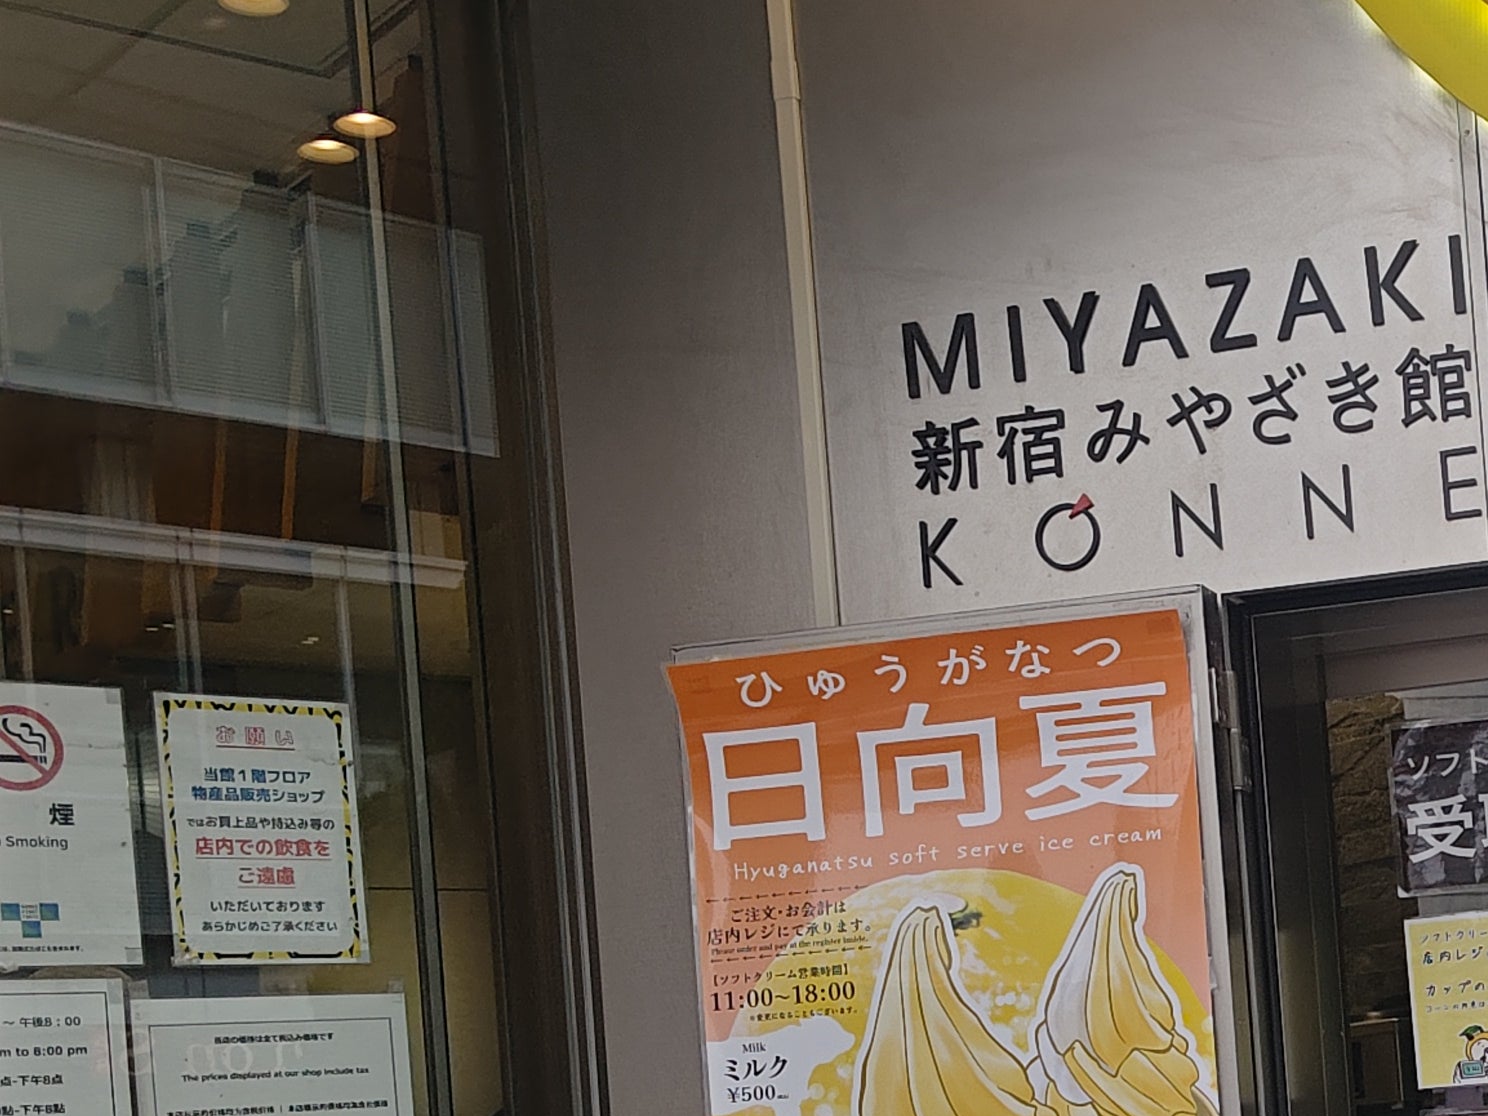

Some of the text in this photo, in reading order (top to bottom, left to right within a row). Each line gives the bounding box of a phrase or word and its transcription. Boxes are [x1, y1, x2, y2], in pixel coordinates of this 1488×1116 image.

[901, 234, 1469, 399] MIYAZAKI
[911, 343, 1474, 496] 新宿みやざき館
[918, 445, 1484, 589] KONNE
[735, 636, 1122, 709] ひゅうがなつ
[702, 681, 1180, 851] 日向夏
[191, 785, 325, 804] 物産品販売ショップ
[49, 802, 75, 826] 煙
[187, 816, 335, 831] ではお買上品や持込み等の
[5, 836, 69, 851] Smoking
[195, 836, 331, 857] 店内での飲食を
[733, 829, 1163, 881] Hyuganatsu soft serve ice cream
[238, 866, 296, 885] ご遠慮
[210, 900, 325, 913] いただいております
[731, 899, 846, 923] ご注文・お会計は
[202, 920, 338, 933] あらかじめご了承ください
[707, 918, 872, 946] 店内レジにて承ります。
[713, 963, 849, 987] 【ソフトクリーム営業時間】
[16, 1049, 29, 1057] to
[67, 1046, 88, 1057] pm
[742, 1042, 766, 1054] Milk
[182, 1074, 199, 1083] The
[723, 1055, 788, 1082] ミルク
